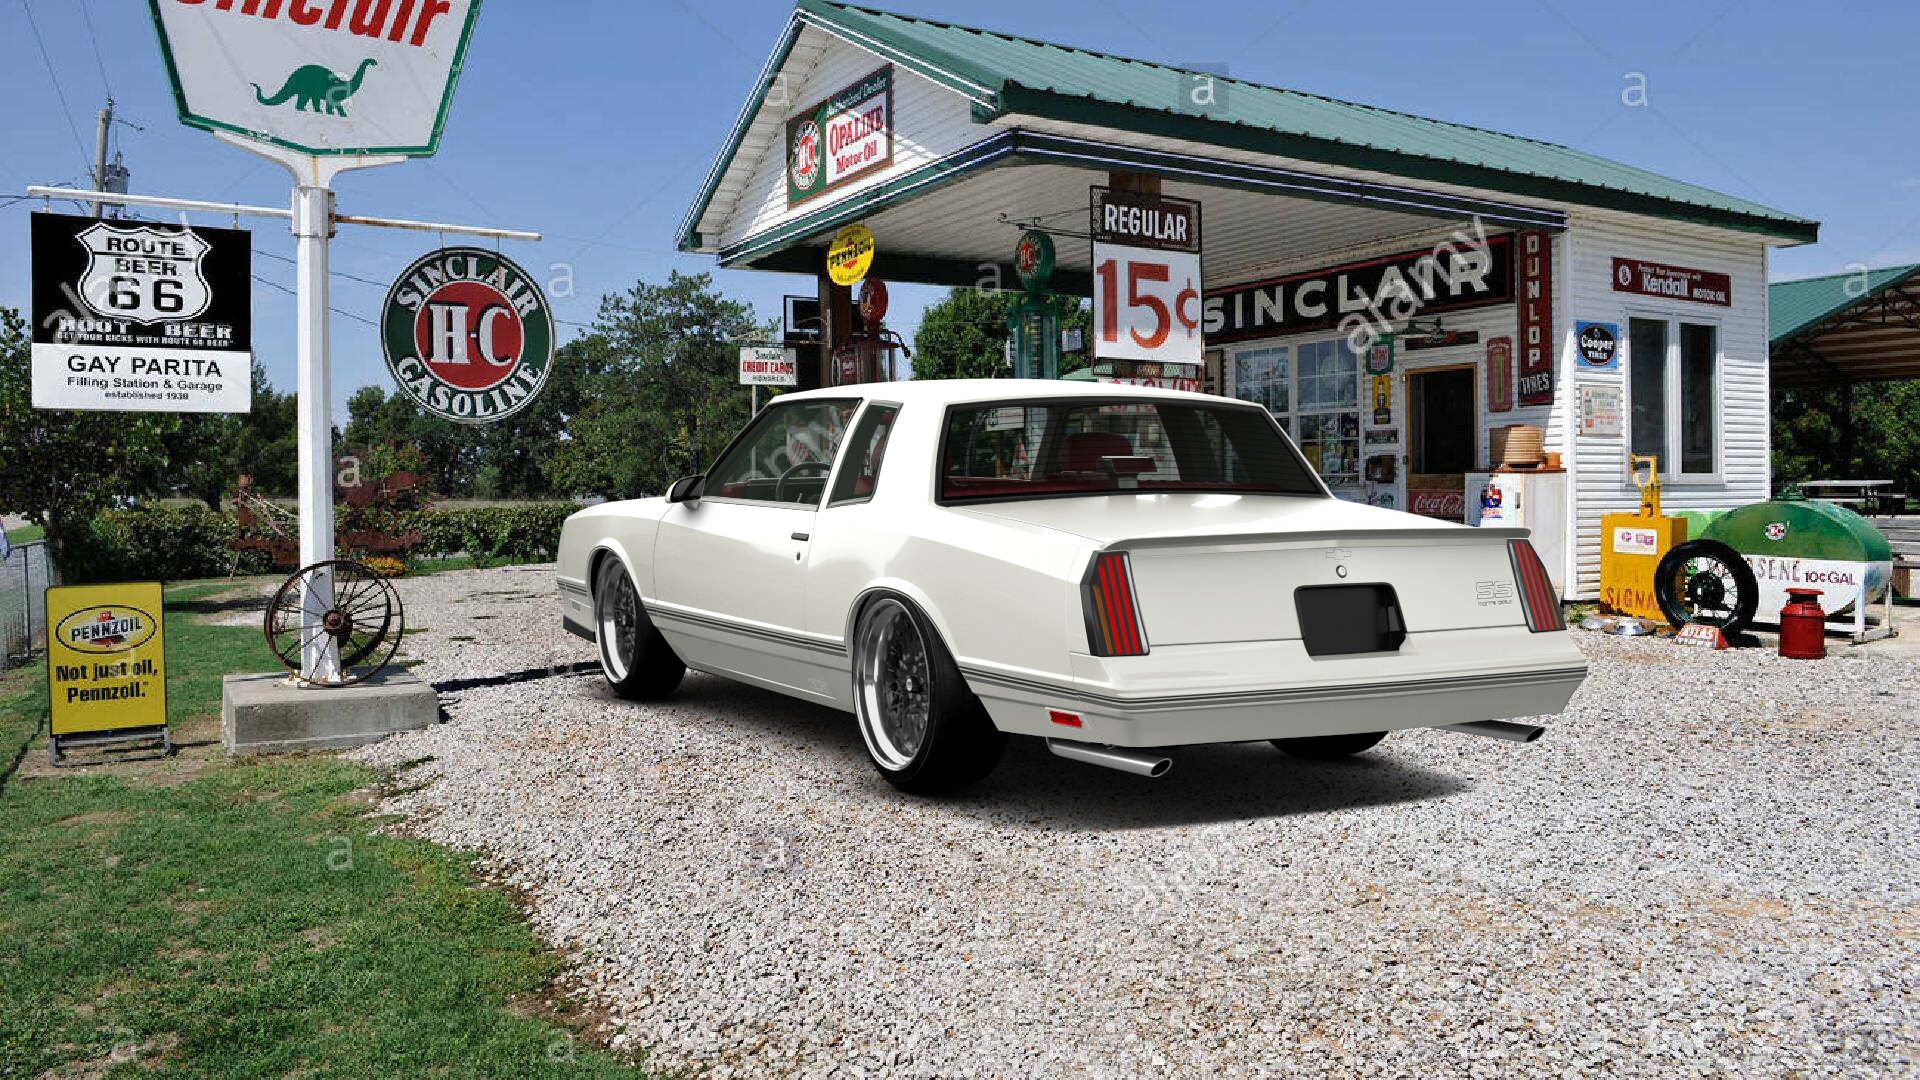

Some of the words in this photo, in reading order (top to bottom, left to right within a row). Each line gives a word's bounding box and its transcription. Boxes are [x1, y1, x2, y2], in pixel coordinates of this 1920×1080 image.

[829, 105, 883, 157] OPALINE
[836, 151, 862, 174] Motor
[863, 139, 878, 162] Oil
[1104, 203, 1187, 242] REGULAR
[106, 237, 186, 256] ROUTE
[115, 258, 178, 276] BEER
[108, 275, 184, 313] 66
[396, 256, 539, 318] SINCLAIR
[1203, 249, 1489, 333] SINCLAIR
[1642, 272, 1689, 296] Kendall
[1526, 234, 1541, 367] DUNLOP
[77, 333, 103, 341] YOUR
[105, 334, 134, 343] KICKS
[136, 336, 159, 344] WITH
[161, 337, 190, 345] ROUTE
[164, 322, 233, 340] BEER
[1581, 335, 1614, 351] Cooper
[67, 354, 121, 374] GAY
[131, 356, 223, 378] PARITA
[742, 361, 768, 373] CREDIT
[770, 361, 794, 374] CARDS
[67, 376, 109, 391] Filling
[113, 377, 159, 389] Station
[163, 379, 173, 389] &
[176, 380, 223, 394] Garage
[105, 390, 163, 400] established
[397, 356, 542, 416] GASOLINE
[1520, 371, 1550, 396] TIRES
[1746, 557, 1801, 583] SENE
[1827, 571, 1856, 586] GAL
[1475, 580, 1513, 600] SS
[71, 617, 143, 642] PENNZOIL
[56, 663, 89, 682] Not
[92, 661, 128, 682] just
[131, 659, 159, 678] oil,
